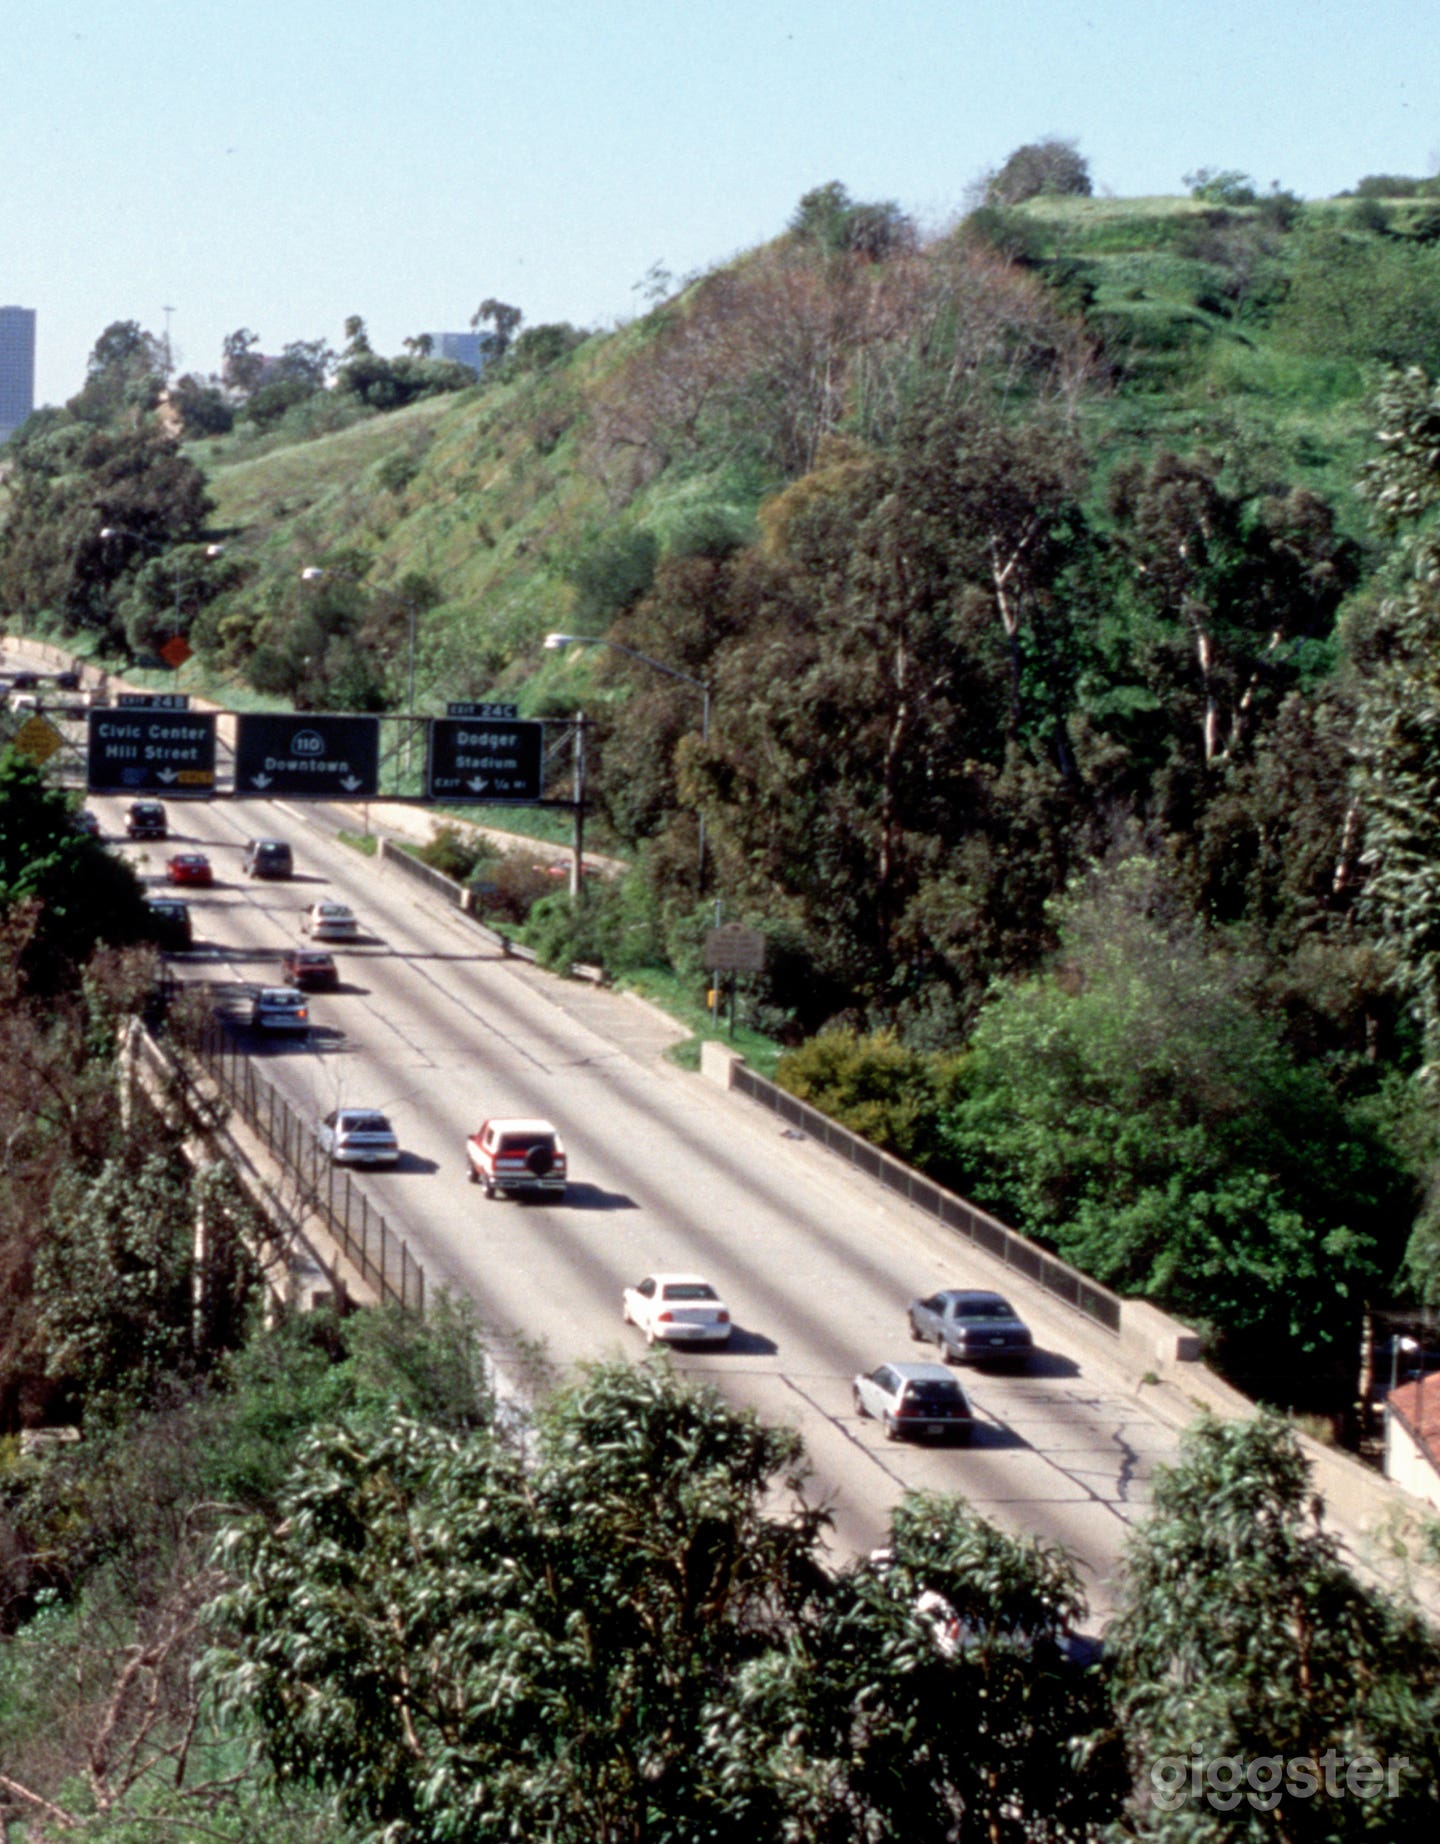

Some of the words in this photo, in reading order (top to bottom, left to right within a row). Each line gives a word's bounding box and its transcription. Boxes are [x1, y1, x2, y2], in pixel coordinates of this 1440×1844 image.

[449, 704, 475, 714] EXIT
[481, 704, 512, 717] 24C
[99, 723, 140, 738] Civic
[148, 724, 206, 740] Center
[297, 738, 320, 751] 110
[457, 731, 517, 750] Dodger
[105, 745, 137, 758] Hill
[144, 745, 197, 760] Street
[264, 757, 349, 772] Downtown
[455, 756, 517, 769] Stadium
